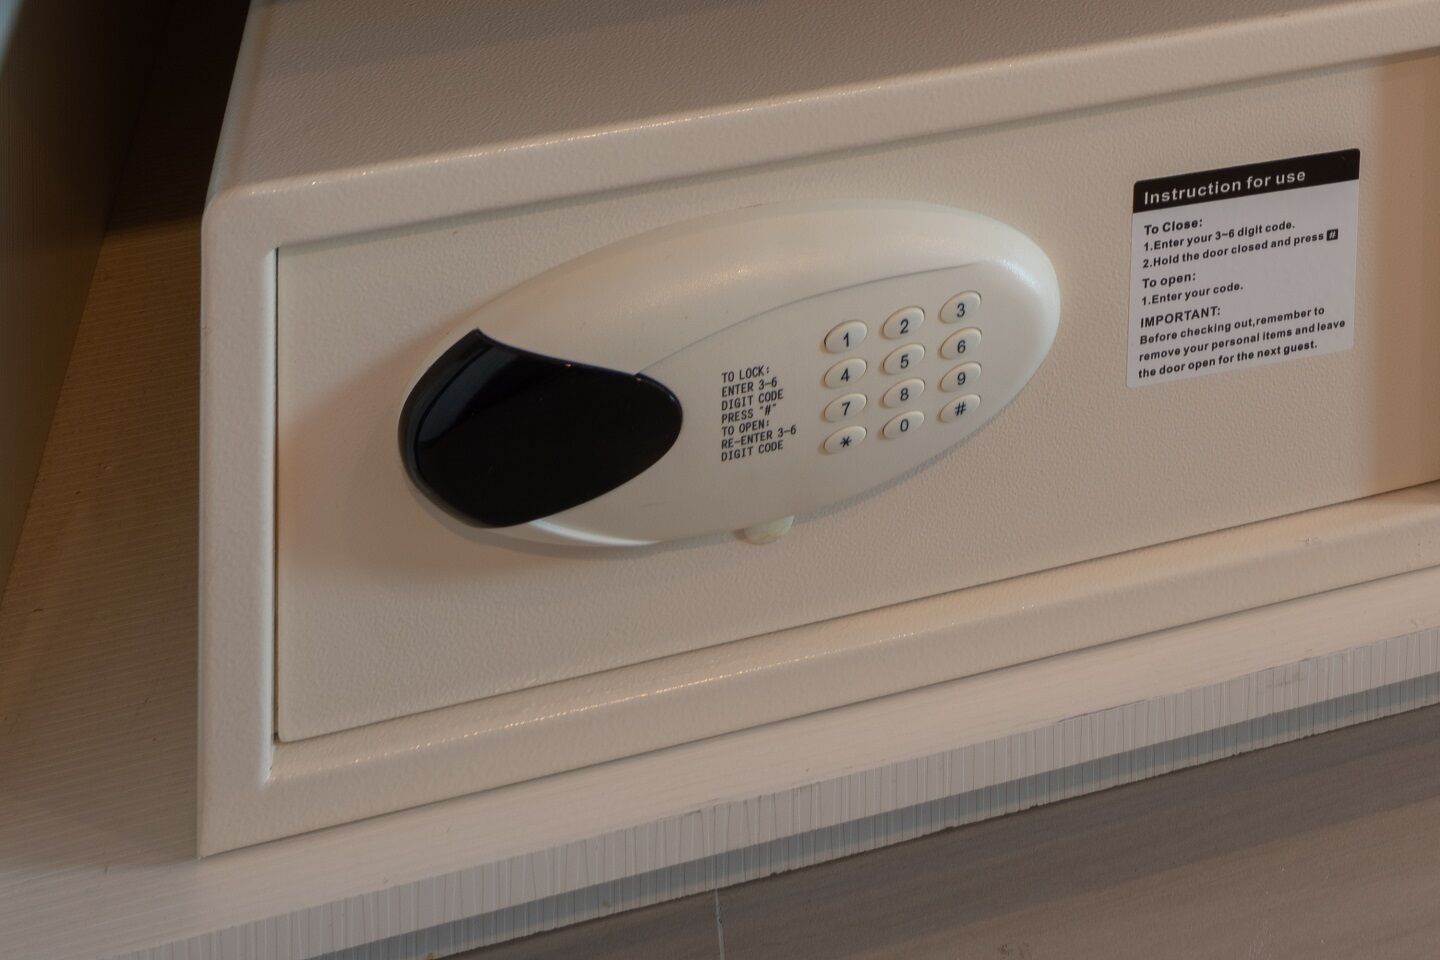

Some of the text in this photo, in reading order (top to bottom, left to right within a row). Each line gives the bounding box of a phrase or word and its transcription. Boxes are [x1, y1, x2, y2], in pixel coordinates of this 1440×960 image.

[1144, 170, 1306, 205] Instruction for use
[1144, 218, 1203, 235] To Close:
[1186, 232, 1213, 246] your
[1238, 224, 1263, 238] digit
[1265, 221, 1295, 232] code.
[1182, 250, 1199, 261] the
[1203, 247, 1228, 259] door
[1231, 241, 1268, 254] closed
[1271, 237, 1291, 248] and
[1294, 232, 1324, 247] press
[1142, 273, 1196, 289] To open:
[1184, 287, 1210, 301] your
[1213, 282, 1243, 295] code.
[956, 304, 966, 318] 3
[1140, 306, 1221, 328] IMPORTANT:
[900, 319, 909, 334] 2
[1140, 332, 1178, 345] Before
[1180, 324, 1231, 338] checking
[1314, 307, 1325, 316] to
[843, 333, 850, 347] 1
[957, 340, 966, 354] 6
[1139, 319, 1345, 362] remove your personal items and leave
[900, 354, 909, 368] 5
[1139, 341, 1318, 378] the door open for the next guest.
[722, 366, 770, 383] TO LOCK:
[840, 368, 850, 382] 4
[957, 372, 966, 386] 9
[722, 377, 778, 398] ENTER 3-6
[900, 388, 909, 402] 8
[722, 390, 784, 410] DIGIT CODE
[722, 409, 753, 424] PRESS
[842, 402, 850, 416] 7
[722, 420, 770, 437] TO OPEN:
[900, 418, 909, 432] 0
[722, 424, 797, 449] RE-ENTER 3-6
[721, 440, 784, 462] DIGIT CODE
